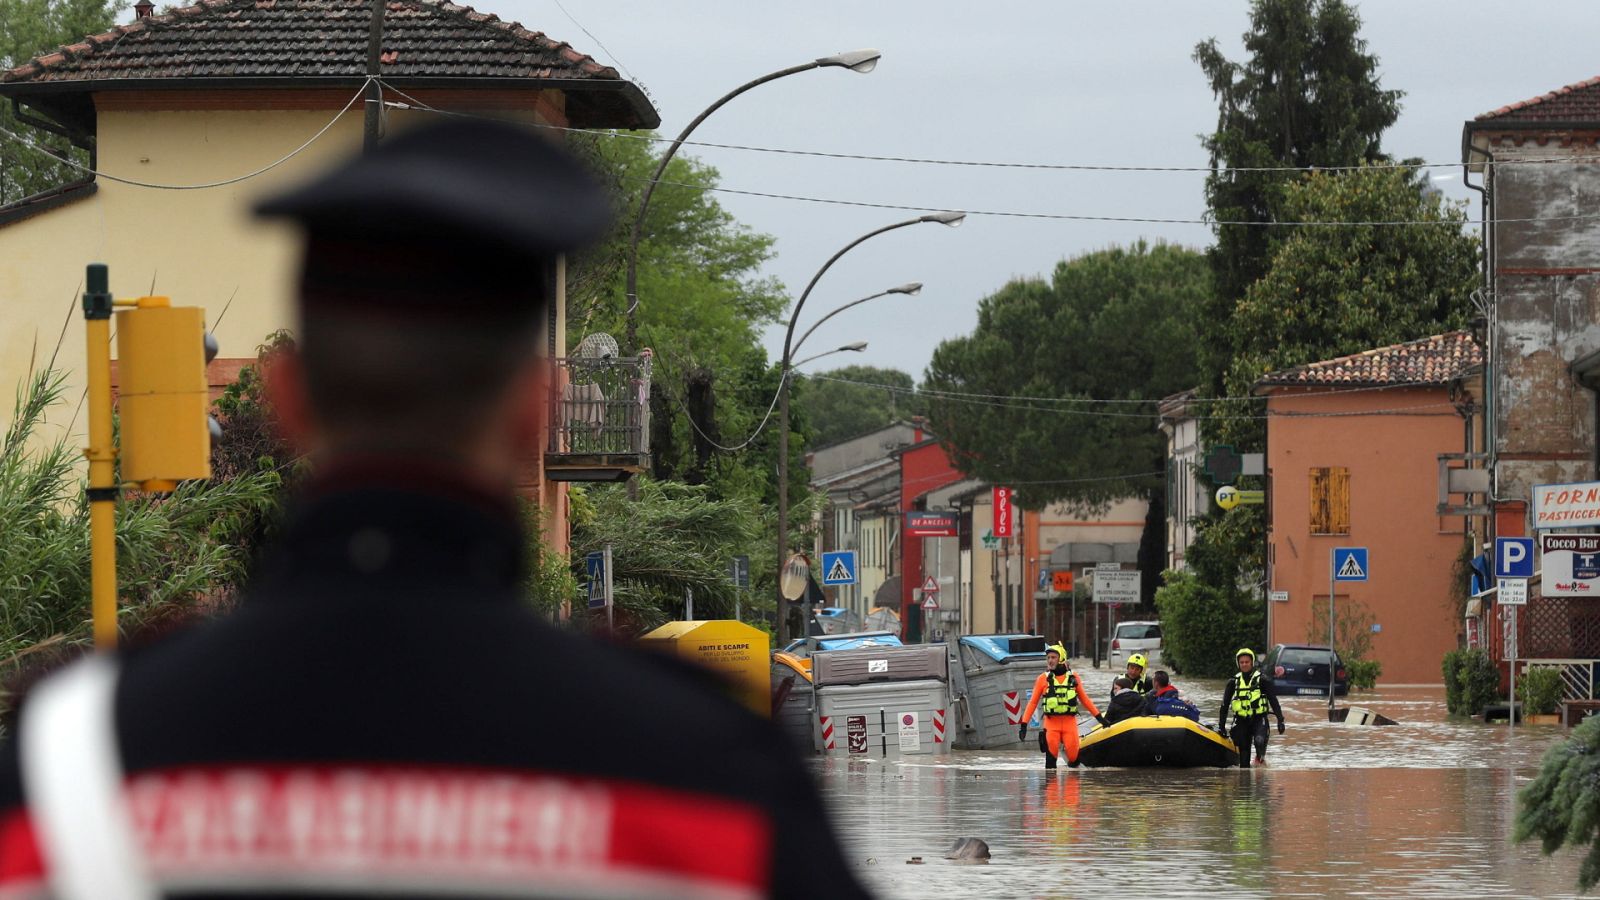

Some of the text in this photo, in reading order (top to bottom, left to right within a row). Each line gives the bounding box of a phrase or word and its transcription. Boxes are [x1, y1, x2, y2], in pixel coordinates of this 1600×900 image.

[1220, 493, 1235, 502] PT
[1544, 489, 1600, 505] FORN
[1546, 537, 1599, 549] Cocco Bar
[1503, 541, 1526, 573] P
[1580, 554, 1595, 567] T
